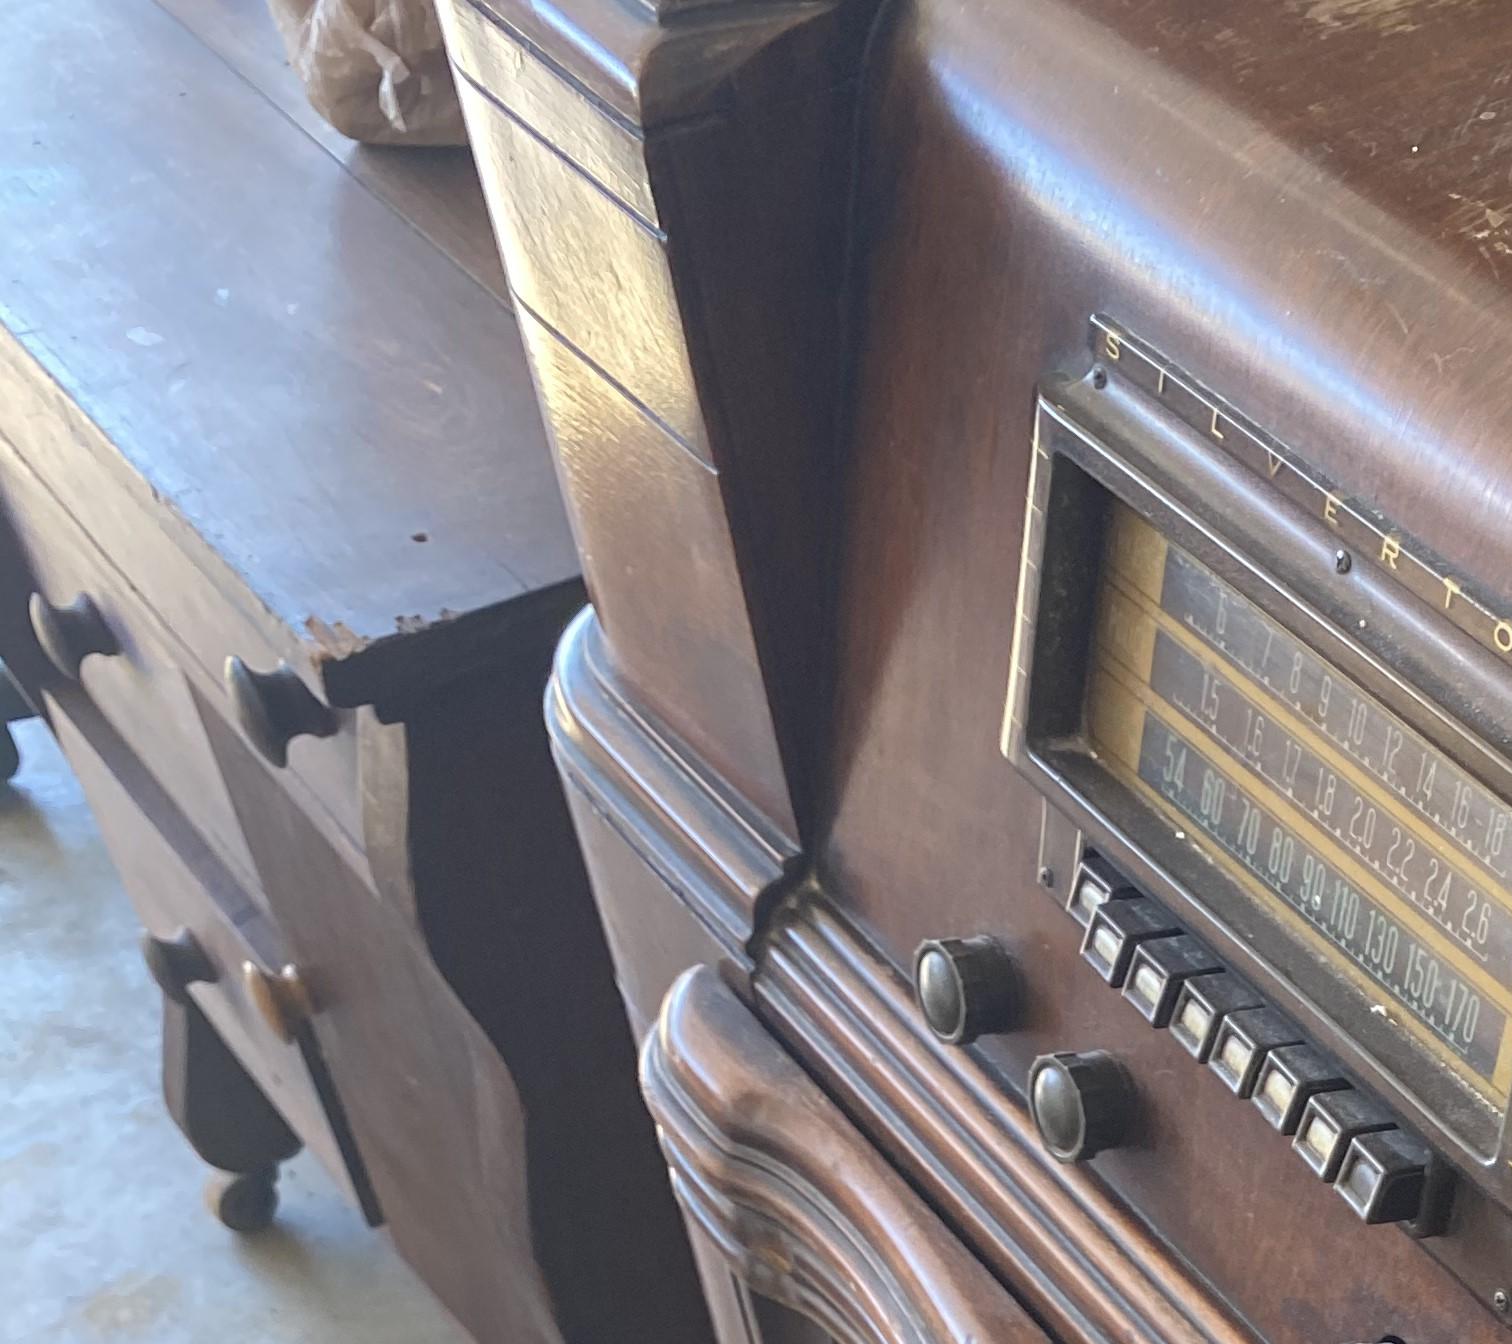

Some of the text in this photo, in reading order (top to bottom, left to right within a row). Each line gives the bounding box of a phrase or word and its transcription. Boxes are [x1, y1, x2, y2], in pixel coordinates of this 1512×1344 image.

[1201, 672, 1492, 945] 1.5 1.6 1.7 1.8 2.0 2.2 2.4 2.6
[1216, 590, 1228, 634] 6
[1289, 651, 1302, 694] 8
[1317, 675, 1333, 718] 9
[1348, 700, 1368, 746] 10
[1382, 725, 1403, 775] 12
[1416, 752, 1437, 801] 14
[1451, 780, 1473, 829] 16
[1162, 734, 1481, 1044] 54 60 70 80 90 110 130 150 170
